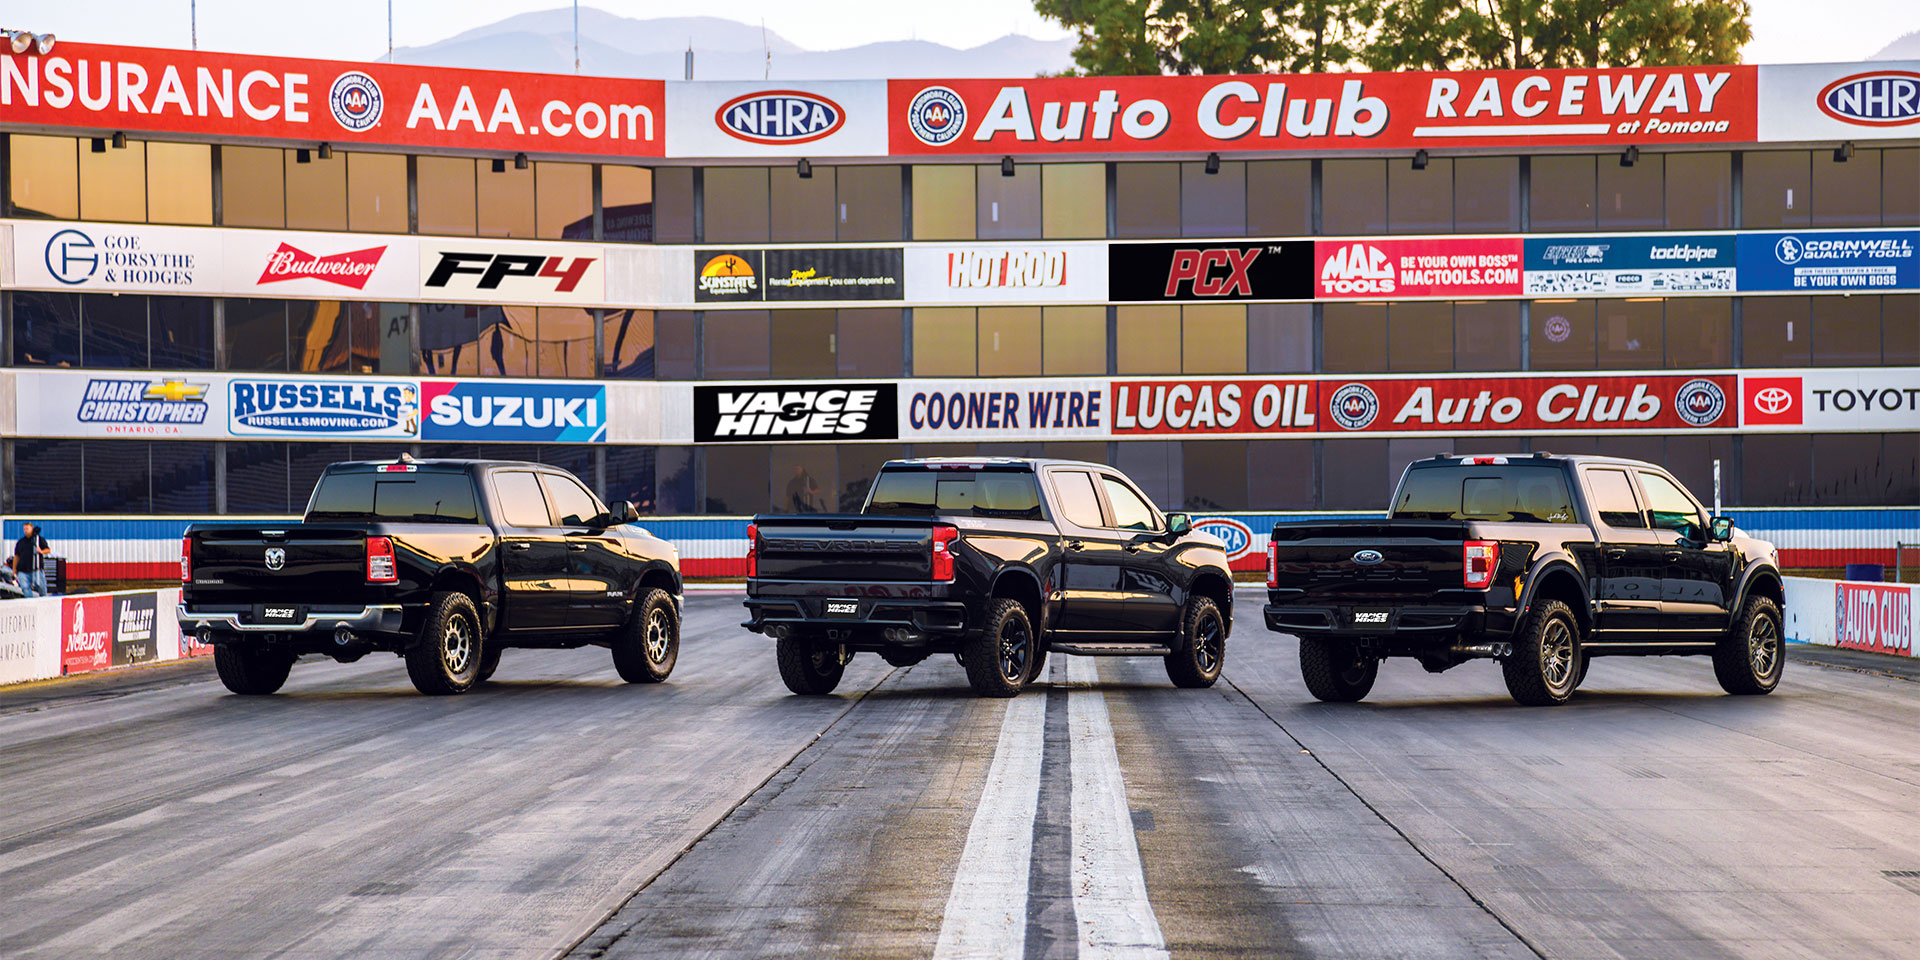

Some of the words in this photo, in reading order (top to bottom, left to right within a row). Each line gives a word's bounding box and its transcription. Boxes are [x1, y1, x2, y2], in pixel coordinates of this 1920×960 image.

[345, 91, 368, 108] AAA
[1425, 72, 1731, 118] RACEWAY
[1838, 80, 1920, 117] NHR
[406, 82, 654, 141] AAA.com
[733, 98, 831, 136] NHRA
[925, 106, 950, 122] AAA
[972, 86, 1170, 141] Auto
[1197, 80, 1390, 140] Club
[1616, 120, 1640, 136] at
[1644, 117, 1730, 135] Pomona
[104, 235, 140, 250] GOE
[1805, 240, 1911, 250] CORNWELL
[105, 252, 195, 269] FORSYTHE
[1321, 244, 1395, 280] MAC
[1401, 256, 1415, 268] BE
[1417, 256, 1448, 268] YOUR
[1450, 256, 1476, 268] OWN
[1650, 244, 1718, 262] toddpipe
[1804, 250, 1862, 259] QUALITY
[1868, 250, 1912, 258] TOOLS
[267, 251, 376, 278] Budweiser
[424, 252, 598, 292] FP4
[951, 250, 1007, 288] HOT
[1003, 250, 1064, 287] ROD
[1165, 248, 1262, 296] PCX
[105, 269, 116, 283] &
[123, 270, 193, 285] HODGES
[699, 276, 757, 290] SUNSTATE
[858, 277, 883, 286] depend
[1321, 279, 1396, 293] TOOLS
[1401, 268, 1518, 286] MACTOOLS.COM
[1794, 276, 1807, 287] BE
[1810, 276, 1838, 286] YOUR
[1841, 276, 1866, 286] OWN
[1869, 275, 1896, 286] BOSS
[86, 381, 146, 400] MARK
[1812, 388, 1920, 411] TOYOT
[234, 383, 402, 419] RUSSELLS
[717, 390, 878, 414] VANCE
[910, 392, 1020, 429] COONER
[1029, 390, 1101, 428] WIRE
[1115, 384, 1242, 429] LUCAS
[1253, 384, 1315, 428] OIL
[1344, 400, 1365, 412] AAA
[1392, 386, 1522, 424] Auto
[1536, 384, 1662, 422] Club
[1690, 396, 1710, 407] AAA
[80, 402, 206, 422] CHRISTOPHER
[430, 395, 597, 428] SUZUKI
[106, 426, 158, 434] ONTARIO,
[248, 416, 388, 428] RUSSELLSMOVING.COM
[714, 413, 870, 436] HINES
[1846, 589, 1877, 647] AUTO
[1881, 590, 1909, 650] CLUB
[66, 632, 105, 652] NORDIC
